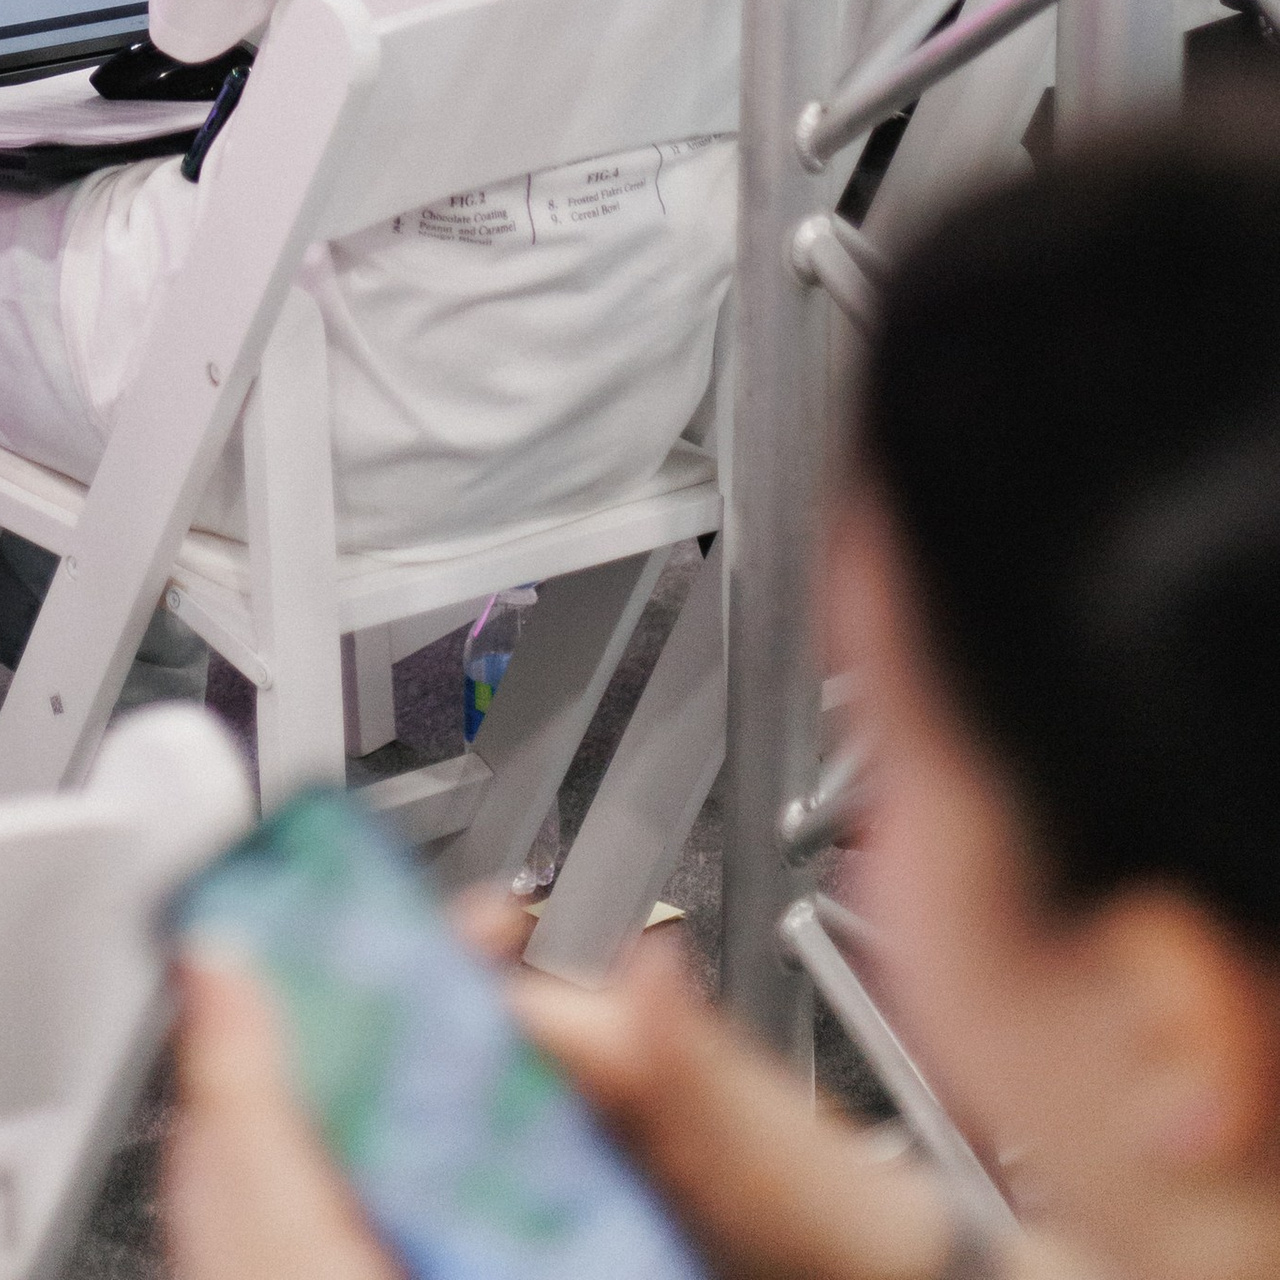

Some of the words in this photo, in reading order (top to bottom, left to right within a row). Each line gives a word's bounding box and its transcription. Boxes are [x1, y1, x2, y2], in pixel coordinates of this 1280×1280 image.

[568, 192, 599, 207] Frosted
[601, 185, 623, 200] Flakes
[624, 178, 647, 193] Cereal
[422, 209, 470, 223] Chocolate
[474, 210, 508, 222] Coating
[571, 208, 599, 223] Cereal
[601, 202, 620, 216] Bowl
[459, 226, 476, 236] and
[479, 221, 517, 236] Caramel
